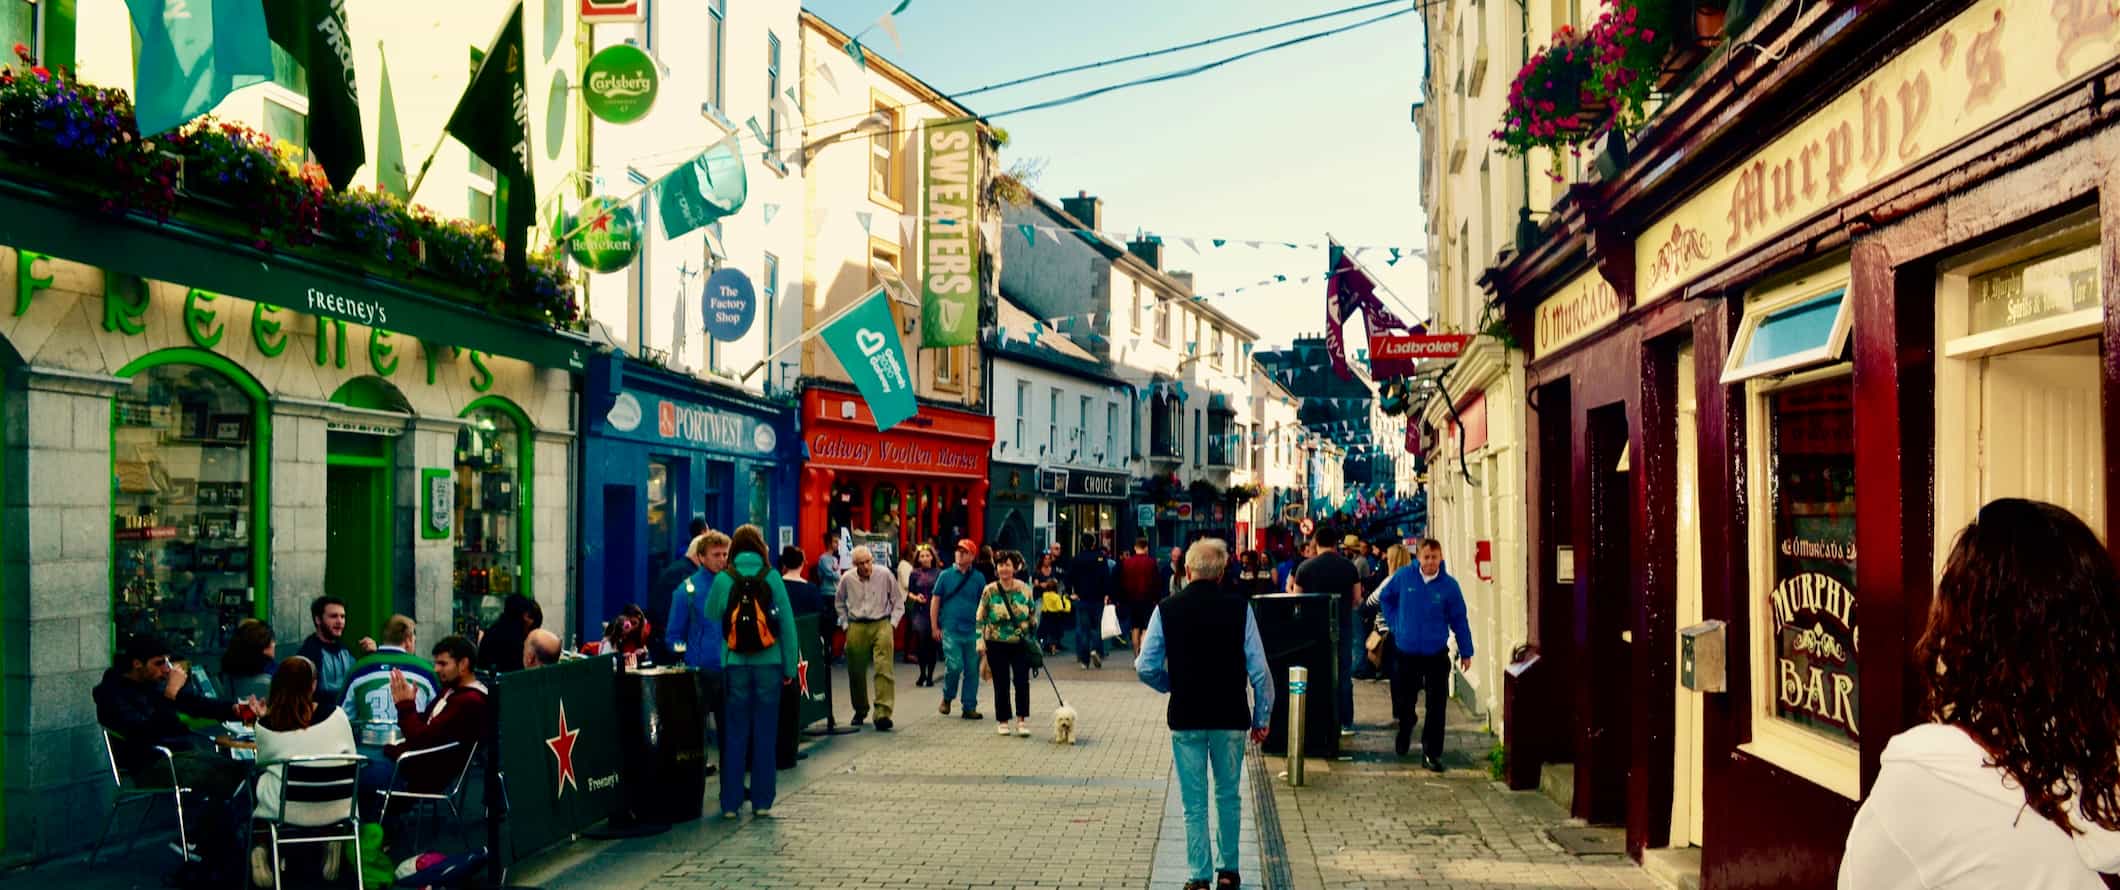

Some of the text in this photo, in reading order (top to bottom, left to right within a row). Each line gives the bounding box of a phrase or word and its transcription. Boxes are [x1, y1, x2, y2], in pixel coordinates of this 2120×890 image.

[590, 70, 650, 98] Carlsberg
[929, 130, 972, 294] SWEATERS
[720, 286, 738, 297] The
[710, 298, 746, 311] Factory
[716, 311, 740, 326] Shop
[1386, 341, 1459, 354] Ladbrokes
[675, 406, 744, 448] PORTWEST
[814, 432, 978, 470] Galway Woollen Market
[1084, 477, 1113, 494] CHOICE
[1779, 658, 1860, 736] BAR
